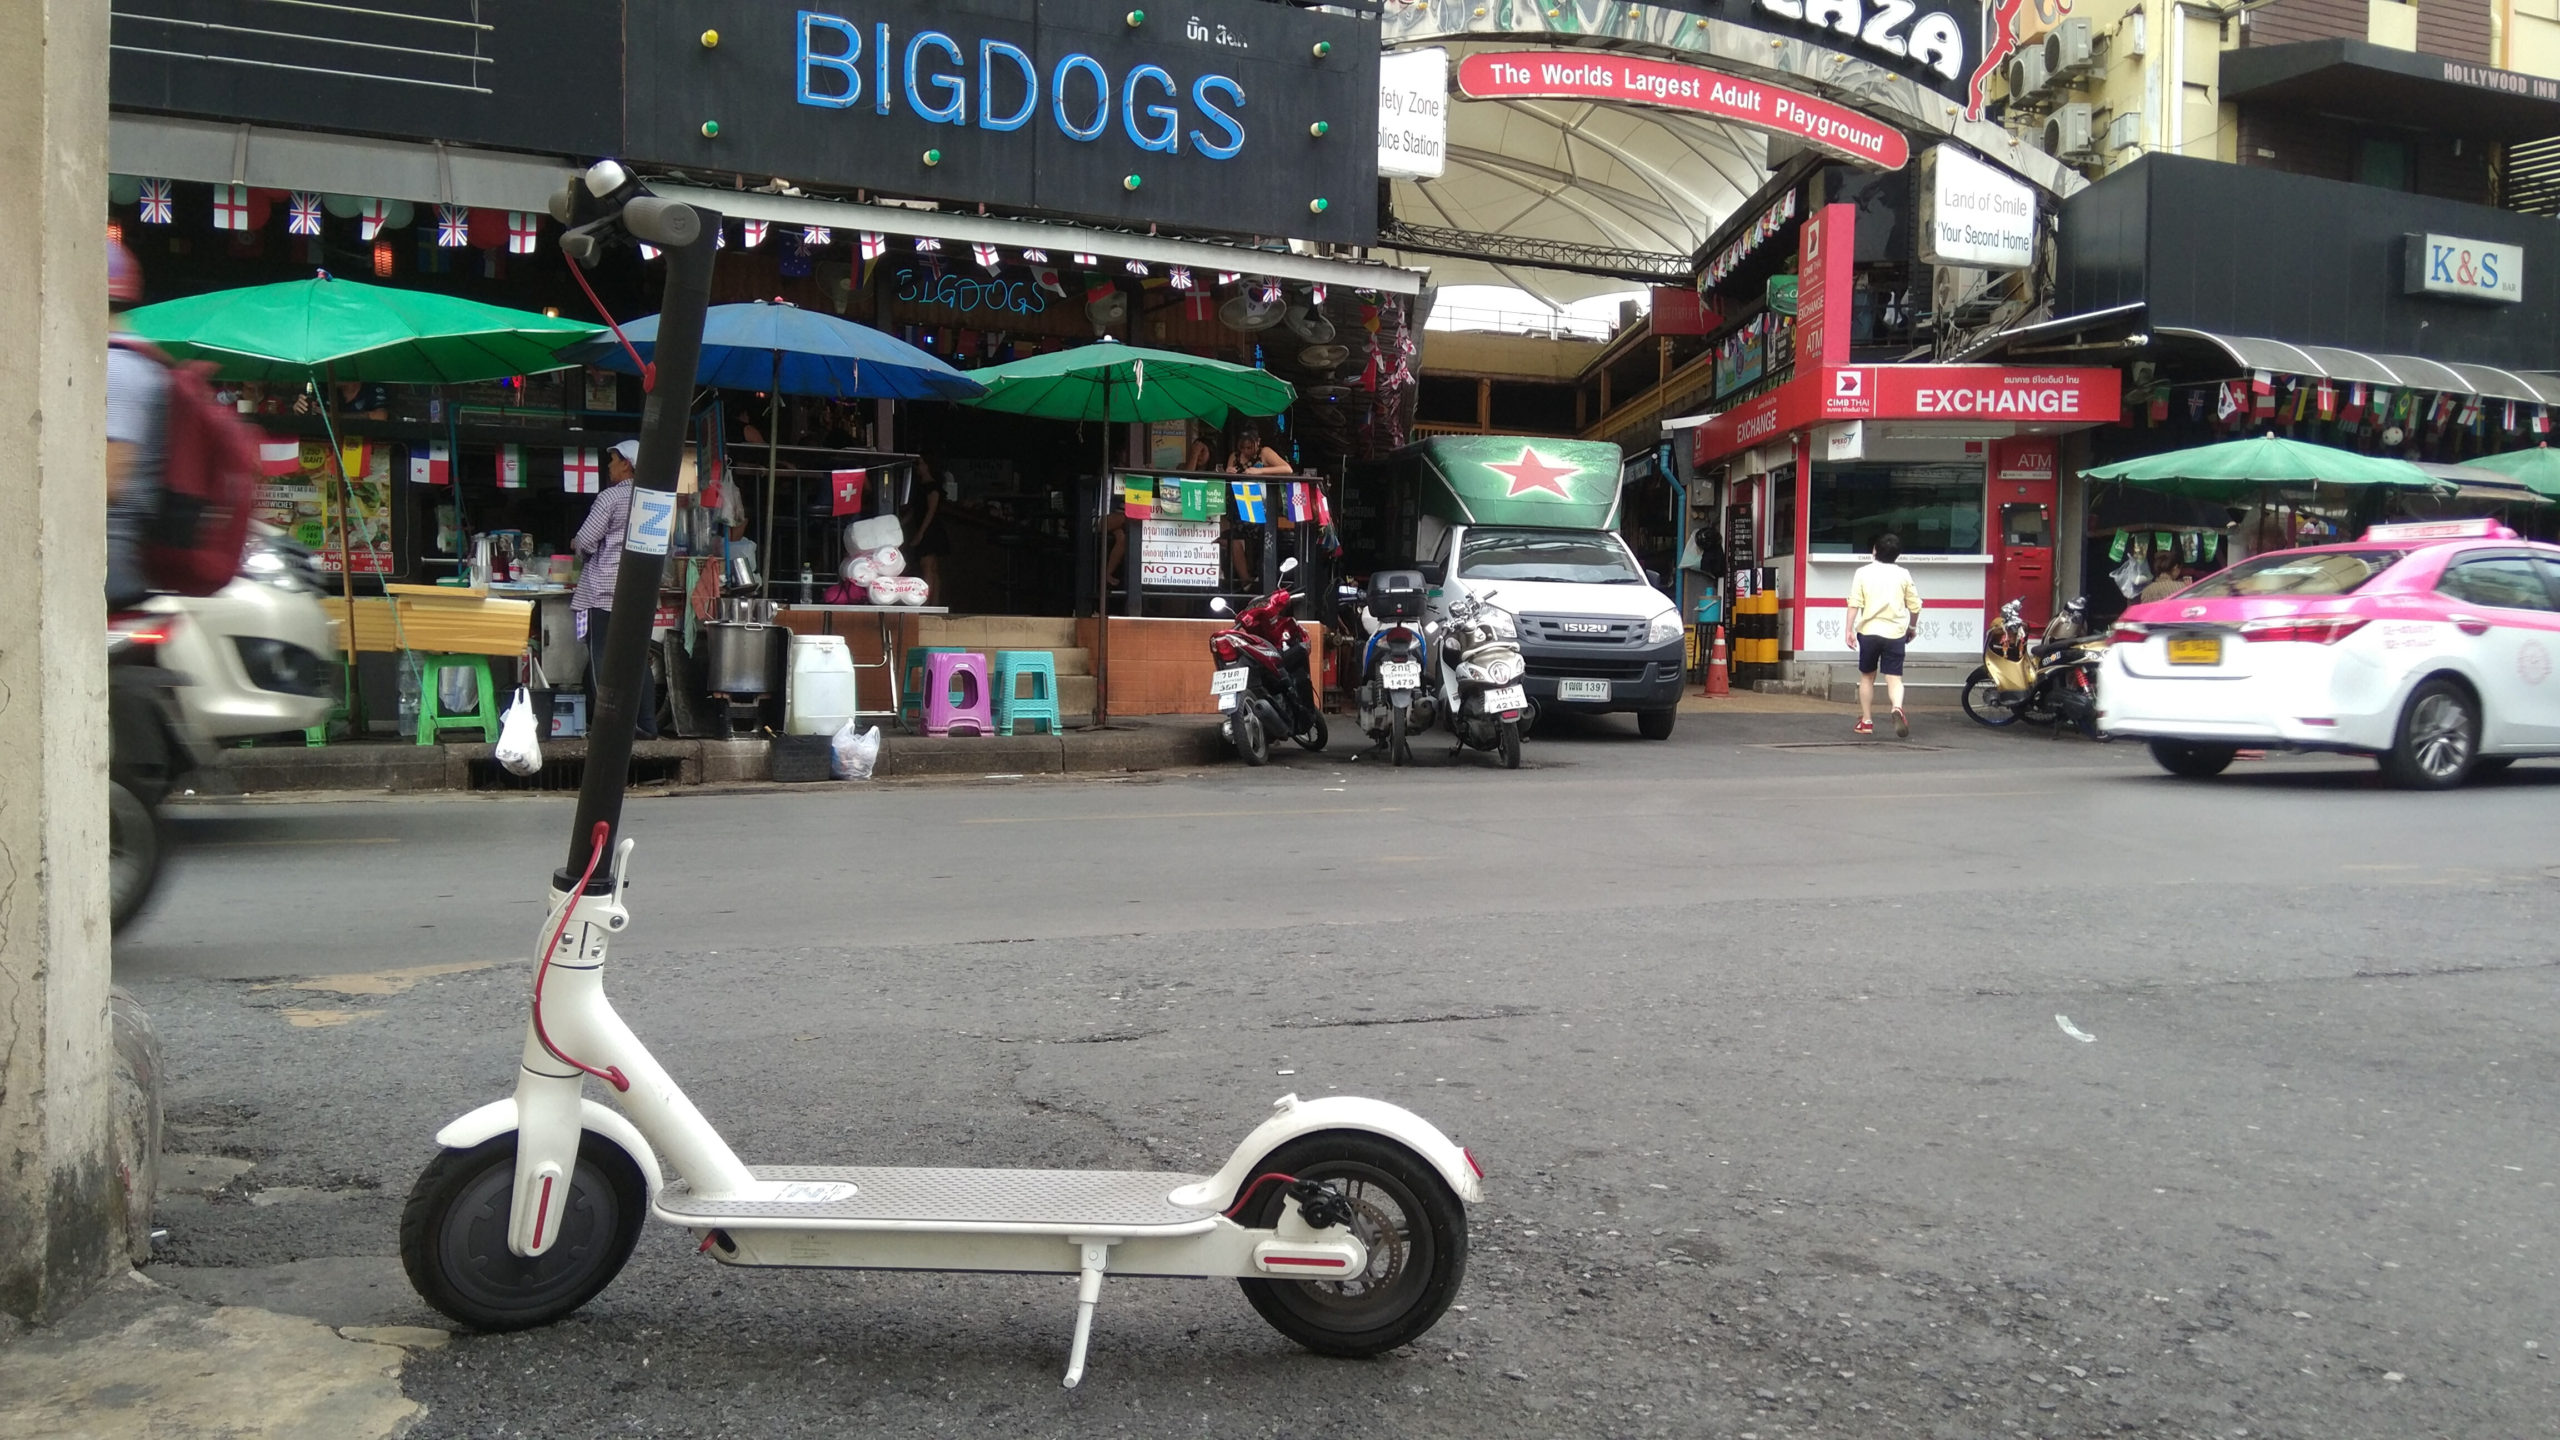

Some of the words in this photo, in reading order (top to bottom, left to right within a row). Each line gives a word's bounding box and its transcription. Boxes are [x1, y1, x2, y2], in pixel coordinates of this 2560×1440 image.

[797, 10, 1246, 160] BIGDOGS
[2443, 62, 2527, 94] HOLLYWOOD
[2533, 79, 2558, 99] INN
[1408, 91, 1439, 117] Zone
[1490, 64, 1530, 85] The
[1541, 64, 1613, 87] Worlds
[1624, 68, 1700, 98] Largest
[1710, 81, 1761, 111] Adult
[1775, 98, 1884, 153] Playground
[1403, 129, 1439, 157] Station
[1944, 187, 1975, 209] Land
[1978, 193, 1991, 211] of
[1994, 194, 2027, 217] Smile
[1965, 224, 1999, 247] Second
[2431, 245, 2498, 288] K&S
[1805, 327, 1823, 356] ATM
[1826, 398, 1849, 406] CIMB
[1916, 388, 2079, 412] EXCHANGE
[1736, 409, 1777, 443] EXCHANGE
[2017, 454, 2052, 468] ATM
[1183, 550, 1192, 559] 20
[1144, 565, 1167, 574] NO
[1173, 566, 1217, 575] DRUG
[1564, 623, 1607, 633] ISUZU
[1391, 678, 1414, 686] 1479
[1585, 682, 1607, 693] 1397
[1496, 700, 1520, 709] 4213
